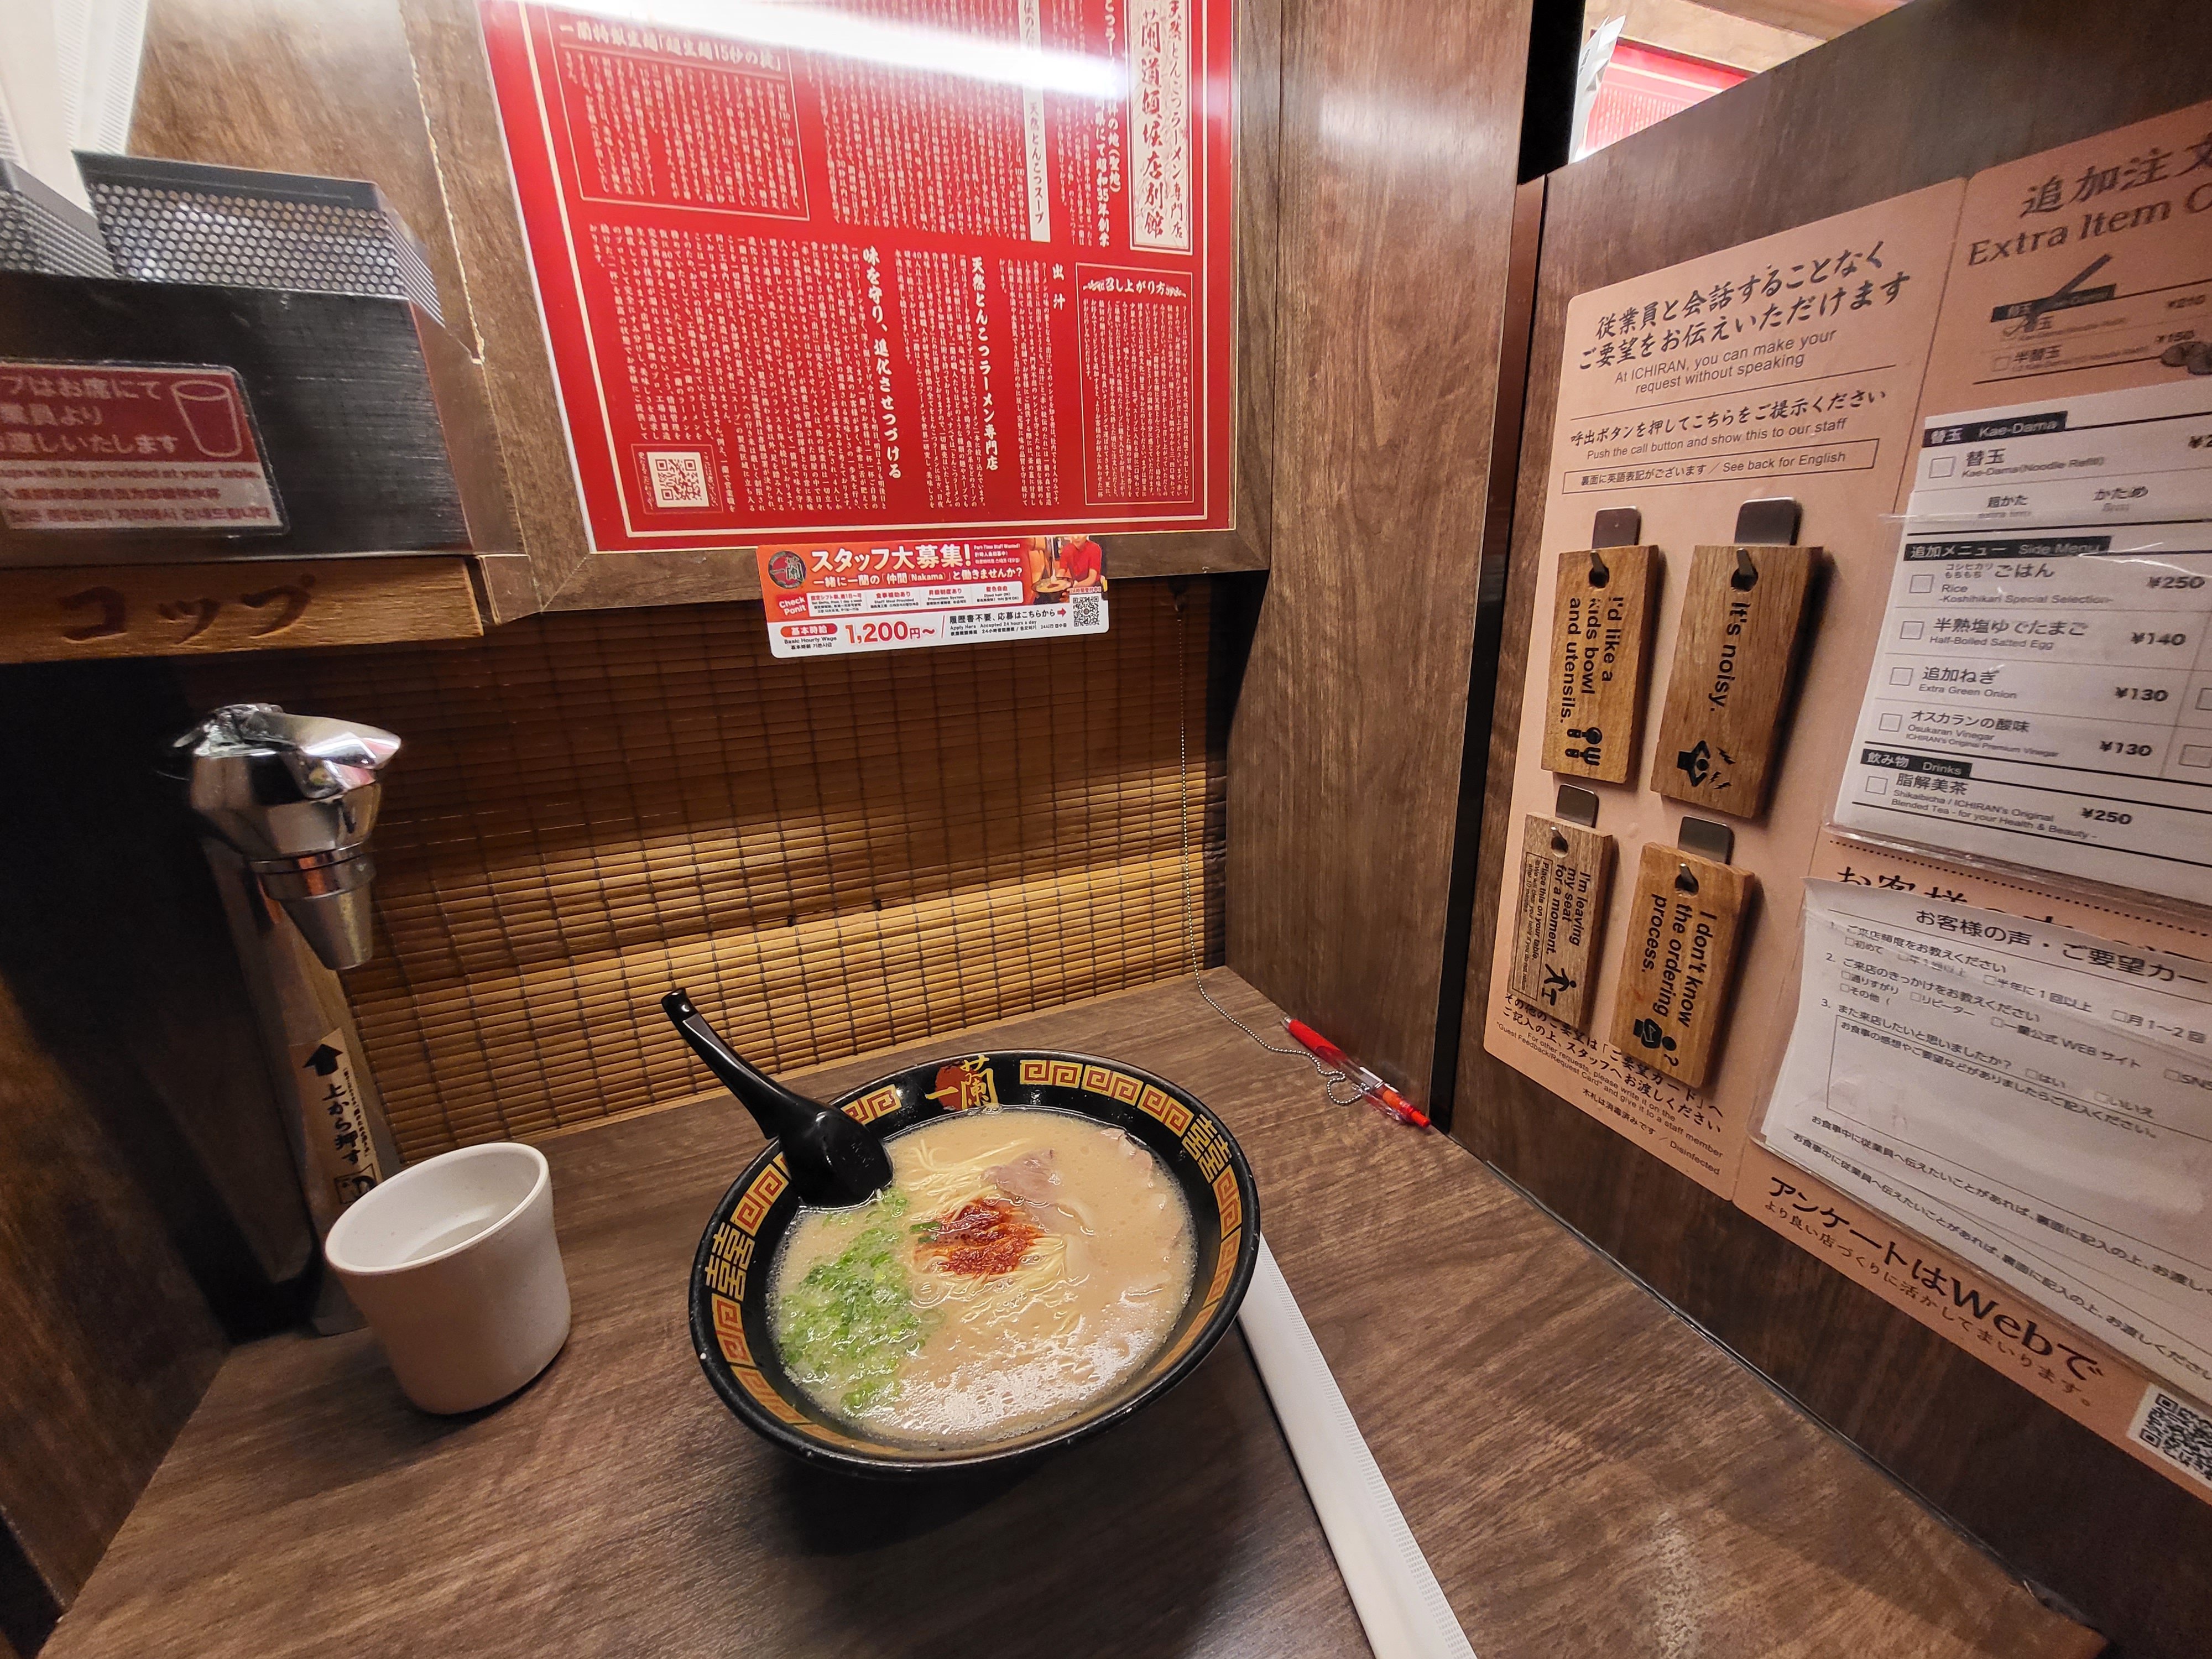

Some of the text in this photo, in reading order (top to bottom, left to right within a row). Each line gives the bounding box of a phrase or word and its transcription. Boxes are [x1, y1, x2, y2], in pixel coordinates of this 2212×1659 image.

[1141, 0, 1163, 239] 蘭道頓堀店別館
[1030, 101, 1044, 224] 天然とんこつスープ
[1968, 199, 2172, 266] Extra Item
[1052, 263, 1066, 310] 出汁
[1105, 277, 1165, 295] 召し上がり方
[1595, 241, 1884, 341] 従業員と会話することなく
[1580, 272, 1910, 369] ご要望をお伝えいただけます
[863, 245, 902, 479] 味を守り、進化させつづける
[972, 256, 998, 471] 天然とんこつラーメン専門店
[1615, 330, 1837, 384] At ICHIRAN, you can make your
[1636, 353, 1804, 394] request without speaking
[1571, 390, 1886, 446] 呼出ボタンを押してこちらをご提示ください
[1931, 420, 2058, 444] 替玉 Kae-Dama
[1588, 417, 1848, 460] Push the call button and show this to our staff
[1581, 464, 1707, 486] 裏面に英語表記がございます
[1723, 452, 1845, 472] See back for English
[1966, 448, 2006, 467] 替玉
[2092, 486, 2148, 502] かため
[811, 544, 971, 573] スタッフ大募集!
[1911, 544, 2101, 559] 追加メニュー Side Menu
[813, 567, 1022, 587] 一緒に一蘭の「仲間(Nakama)」と働きませんか?
[1995, 562, 2054, 578] ごはん
[2147, 576, 2205, 589] ¥250
[779, 597, 806, 608] Check
[1942, 585, 1968, 593] Rice
[54, 573, 317, 645] コップ
[950, 609, 1055, 624] 履歴書不要、応募はこちらから
[791, 627, 827, 636] 基本時給
[1602, 597, 1624, 681] I'd like a
[1930, 636, 1987, 646] Half-Boiled
[2030, 640, 2054, 650] Egg
[1933, 618, 2089, 636] 半熟塩ゆでたまご
[2130, 632, 2187, 646] ¥140
[1560, 598, 1582, 723] and utensils.
[1582, 648, 1599, 694] bowl
[1709, 602, 1751, 711] It's noisy.
[1919, 684, 2017, 699] Extra Green Onion
[1922, 666, 2000, 684] 追加ねぎ
[2114, 686, 2169, 702] ¥130
[1908, 724, 1995, 742] Osukaran Vinegar
[1911, 710, 2031, 733] オスカランの酸味
[1867, 752, 1962, 775] 飲み物 Drinks
[2100, 741, 2153, 757] ¥130
[1896, 773, 1968, 795] 脂解美茶
[2081, 807, 2132, 826] ¥250
[1540, 862, 1549, 886] Place
[1537, 904, 1543, 916] on
[1546, 864, 1567, 955] for a moment.
[1562, 867, 1576, 922] my seat
[1569, 872, 1591, 946] I'm leaving
[1532, 938, 1540, 960] table.
[1641, 894, 1667, 973] process.
[1652, 904, 1693, 1017] the ordering
[1678, 911, 1717, 1027] I don't know
[1843, 958, 2041, 1022] ご来店のきっかけをお教えください
[1851, 975, 1899, 994] 通りすがり
[1922, 995, 1975, 1016] リピーター
[1839, 1005, 2012, 1069] また来店したいと思いましたか?
[925, 1055, 999, 1109] 一蘭
[1503, 1006, 1721, 1133] ご記入の上、スタッフへお渡しください
[1527, 1032, 1676, 1121] For other requests, please write it on the
[1518, 1035, 1579, 1074] Feedback/Request
[1604, 1086, 1619, 1097] and
[1620, 1095, 1637, 1107] give
[1646, 1109, 1654, 1118] to
[1665, 1119, 1684, 1135] staff
[1686, 1133, 1723, 1158] member
[1583, 1088, 1720, 1175] 木札は消毒済みです Disinfected
[1769, 1176, 2104, 1381] アンケートはWebで
[1765, 1201, 2090, 1406] より良い店づくりに活かしてまいります。
